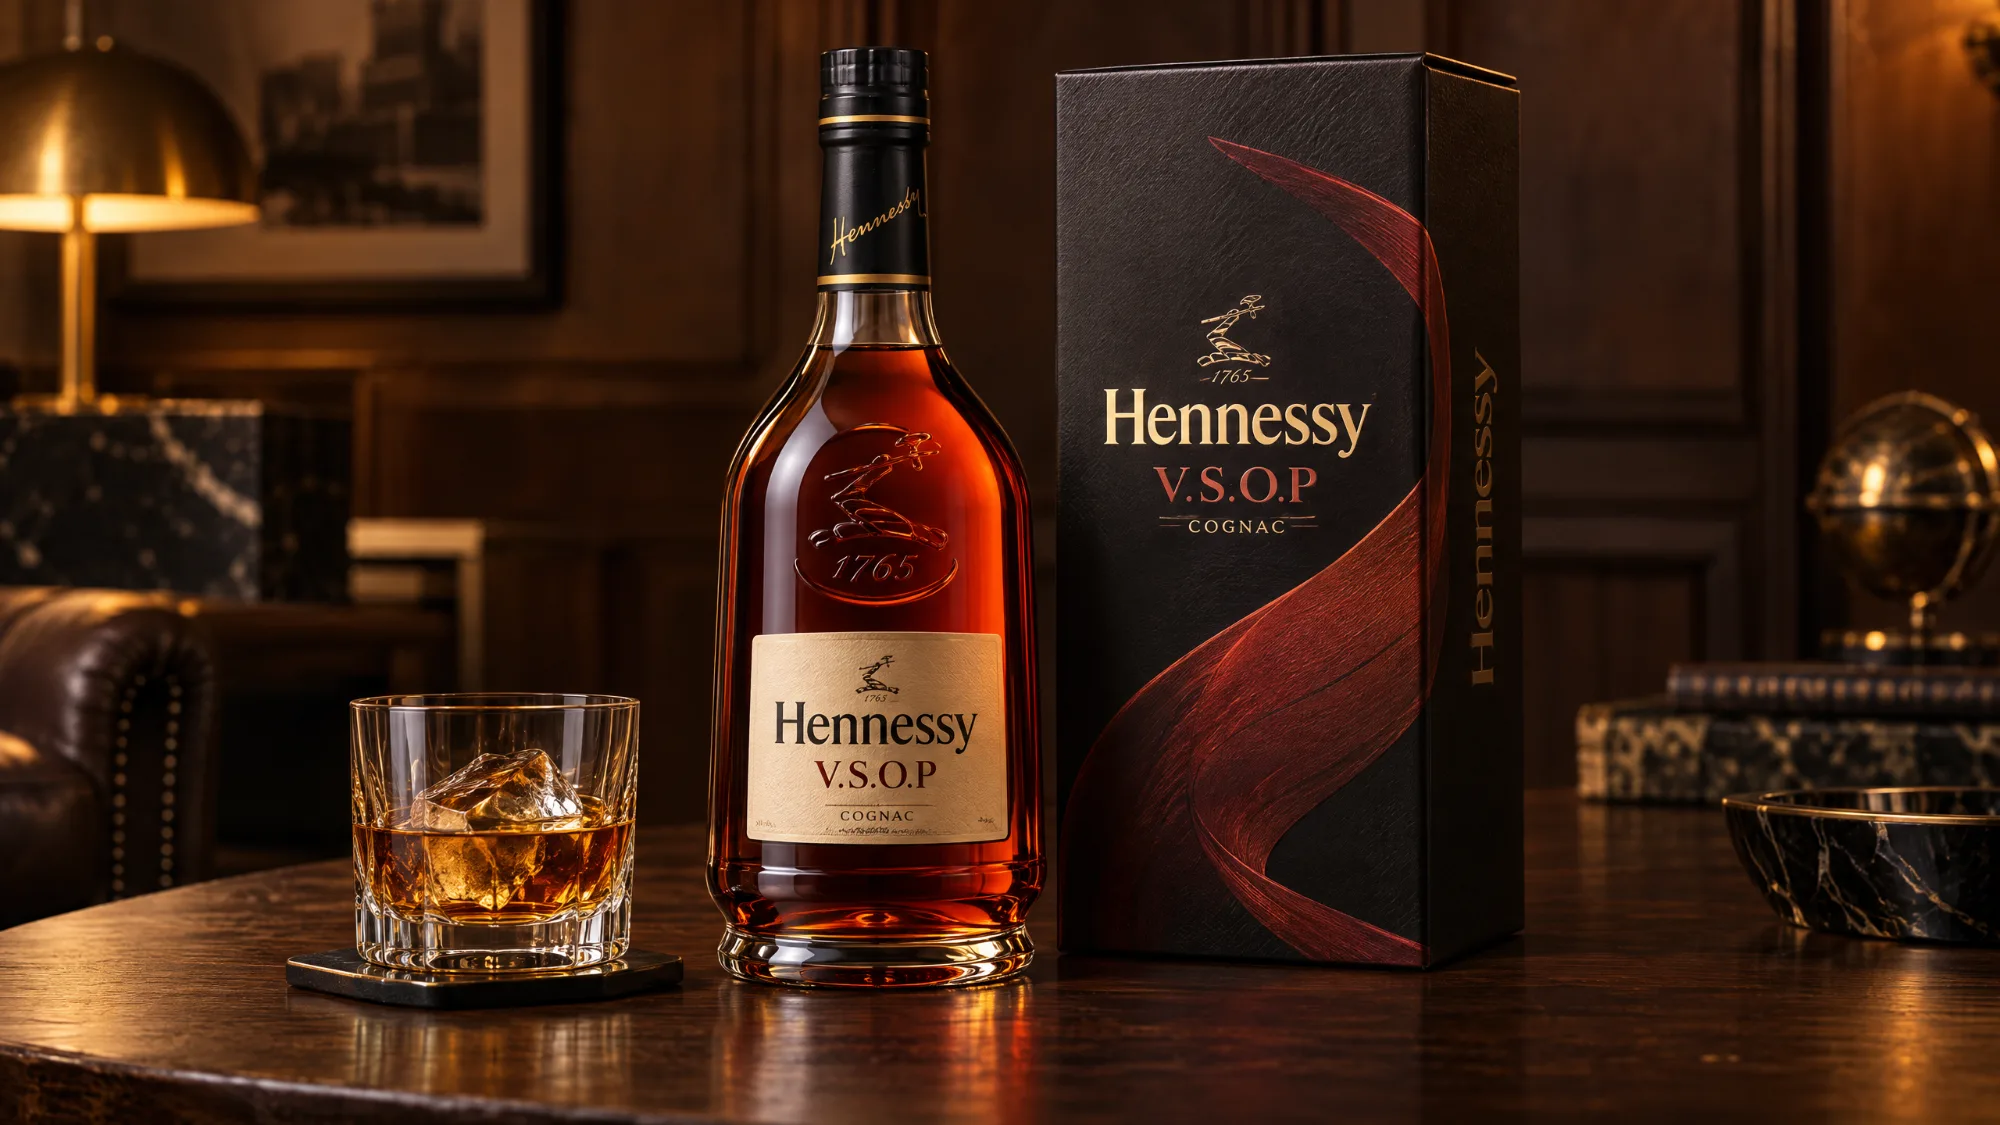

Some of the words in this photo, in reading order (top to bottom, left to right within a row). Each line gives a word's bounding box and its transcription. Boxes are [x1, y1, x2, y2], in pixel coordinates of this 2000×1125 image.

[1211, 369, 1252, 385] 1765
[1103, 388, 1372, 459] Hennessy
[1153, 466, 1318, 504] V.S.O.P
[1188, 519, 1286, 535] COGNAC
[1471, 347, 1498, 686] Hennessy
[832, 553, 919, 583] 1765
[864, 693, 887, 703] 1765
[774, 701, 978, 755] Hennessy
[814, 760, 937, 789] V.S.O.P
[840, 810, 914, 822] COGNAC
